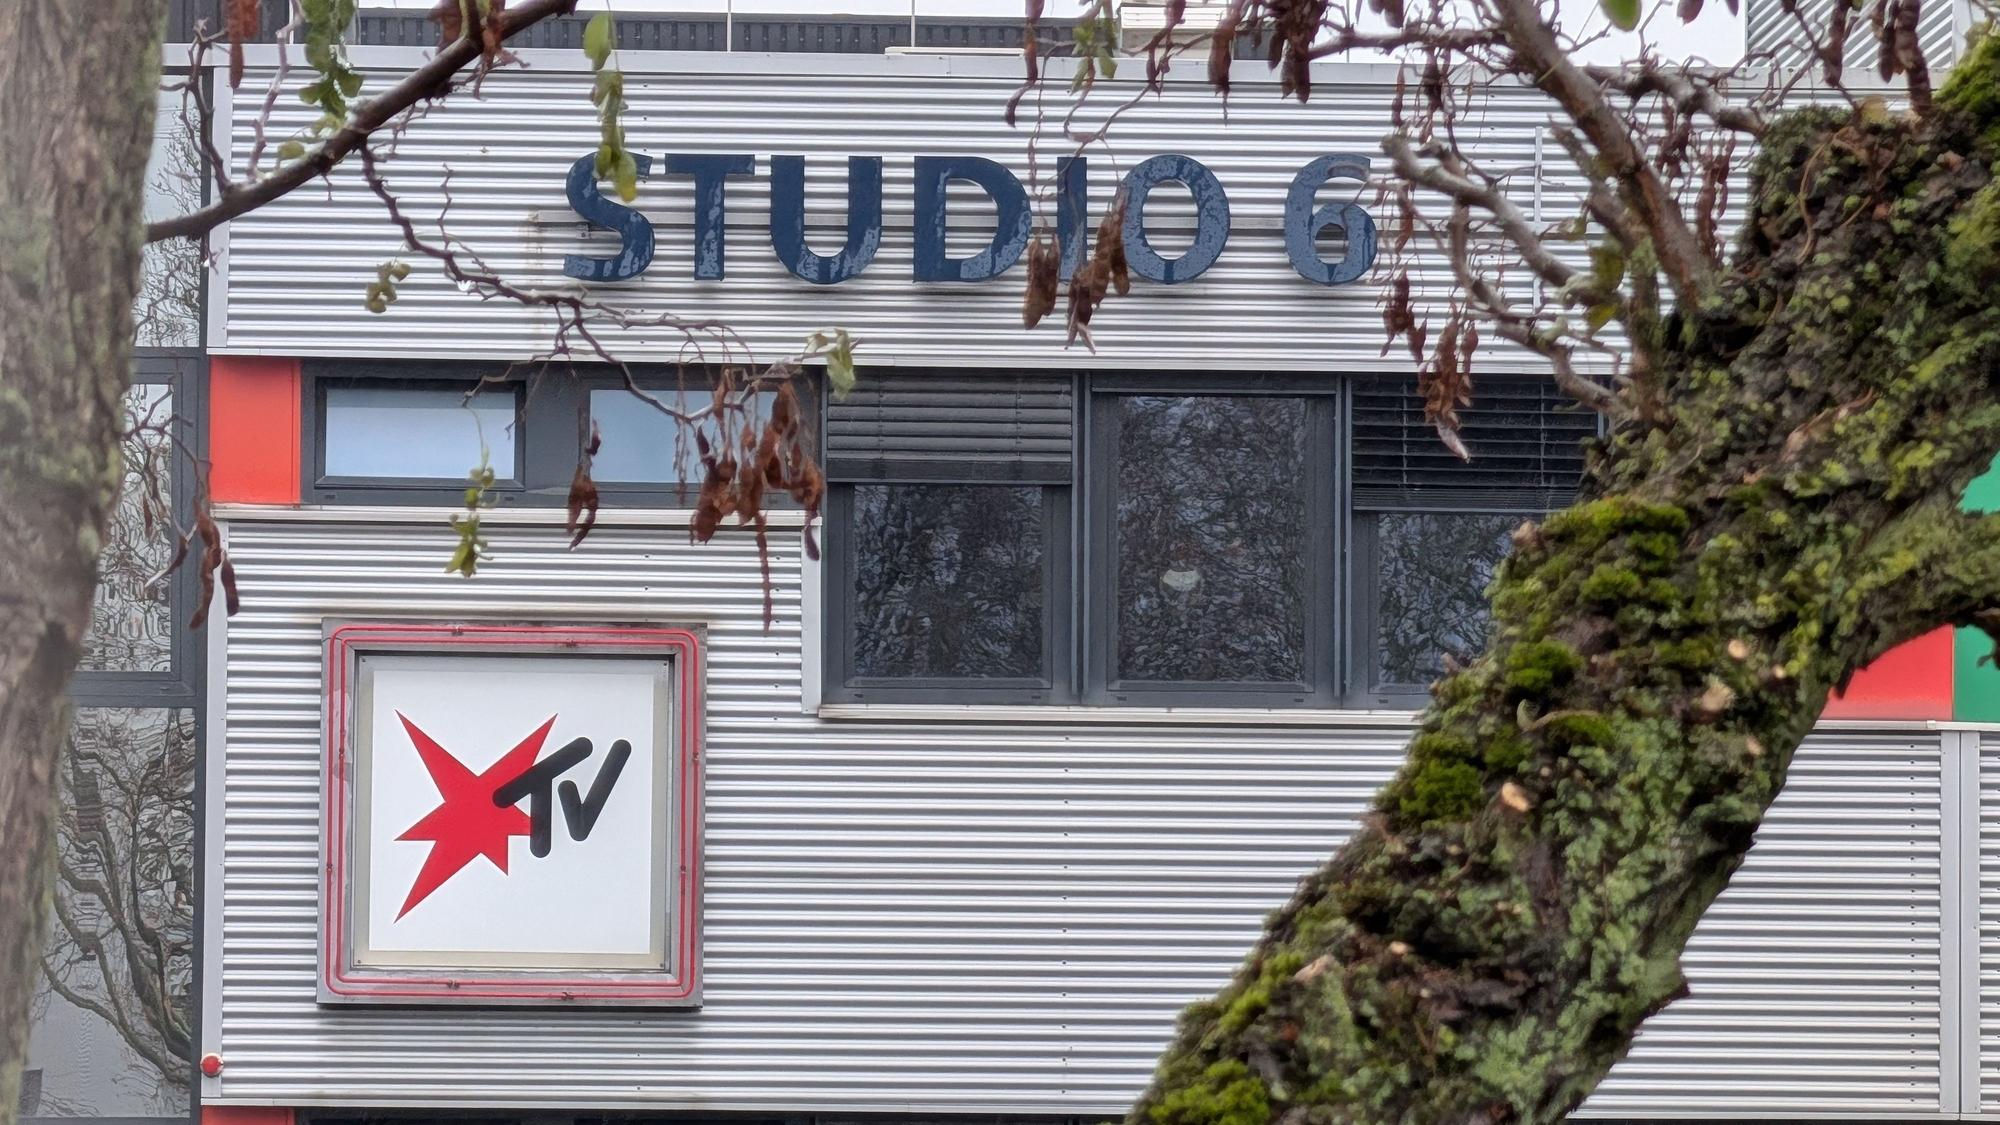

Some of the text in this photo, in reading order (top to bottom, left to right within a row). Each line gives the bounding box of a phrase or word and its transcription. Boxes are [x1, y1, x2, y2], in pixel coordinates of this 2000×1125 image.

[563, 151, 1378, 286] STUDIO 6
[492, 736, 632, 859] TV
